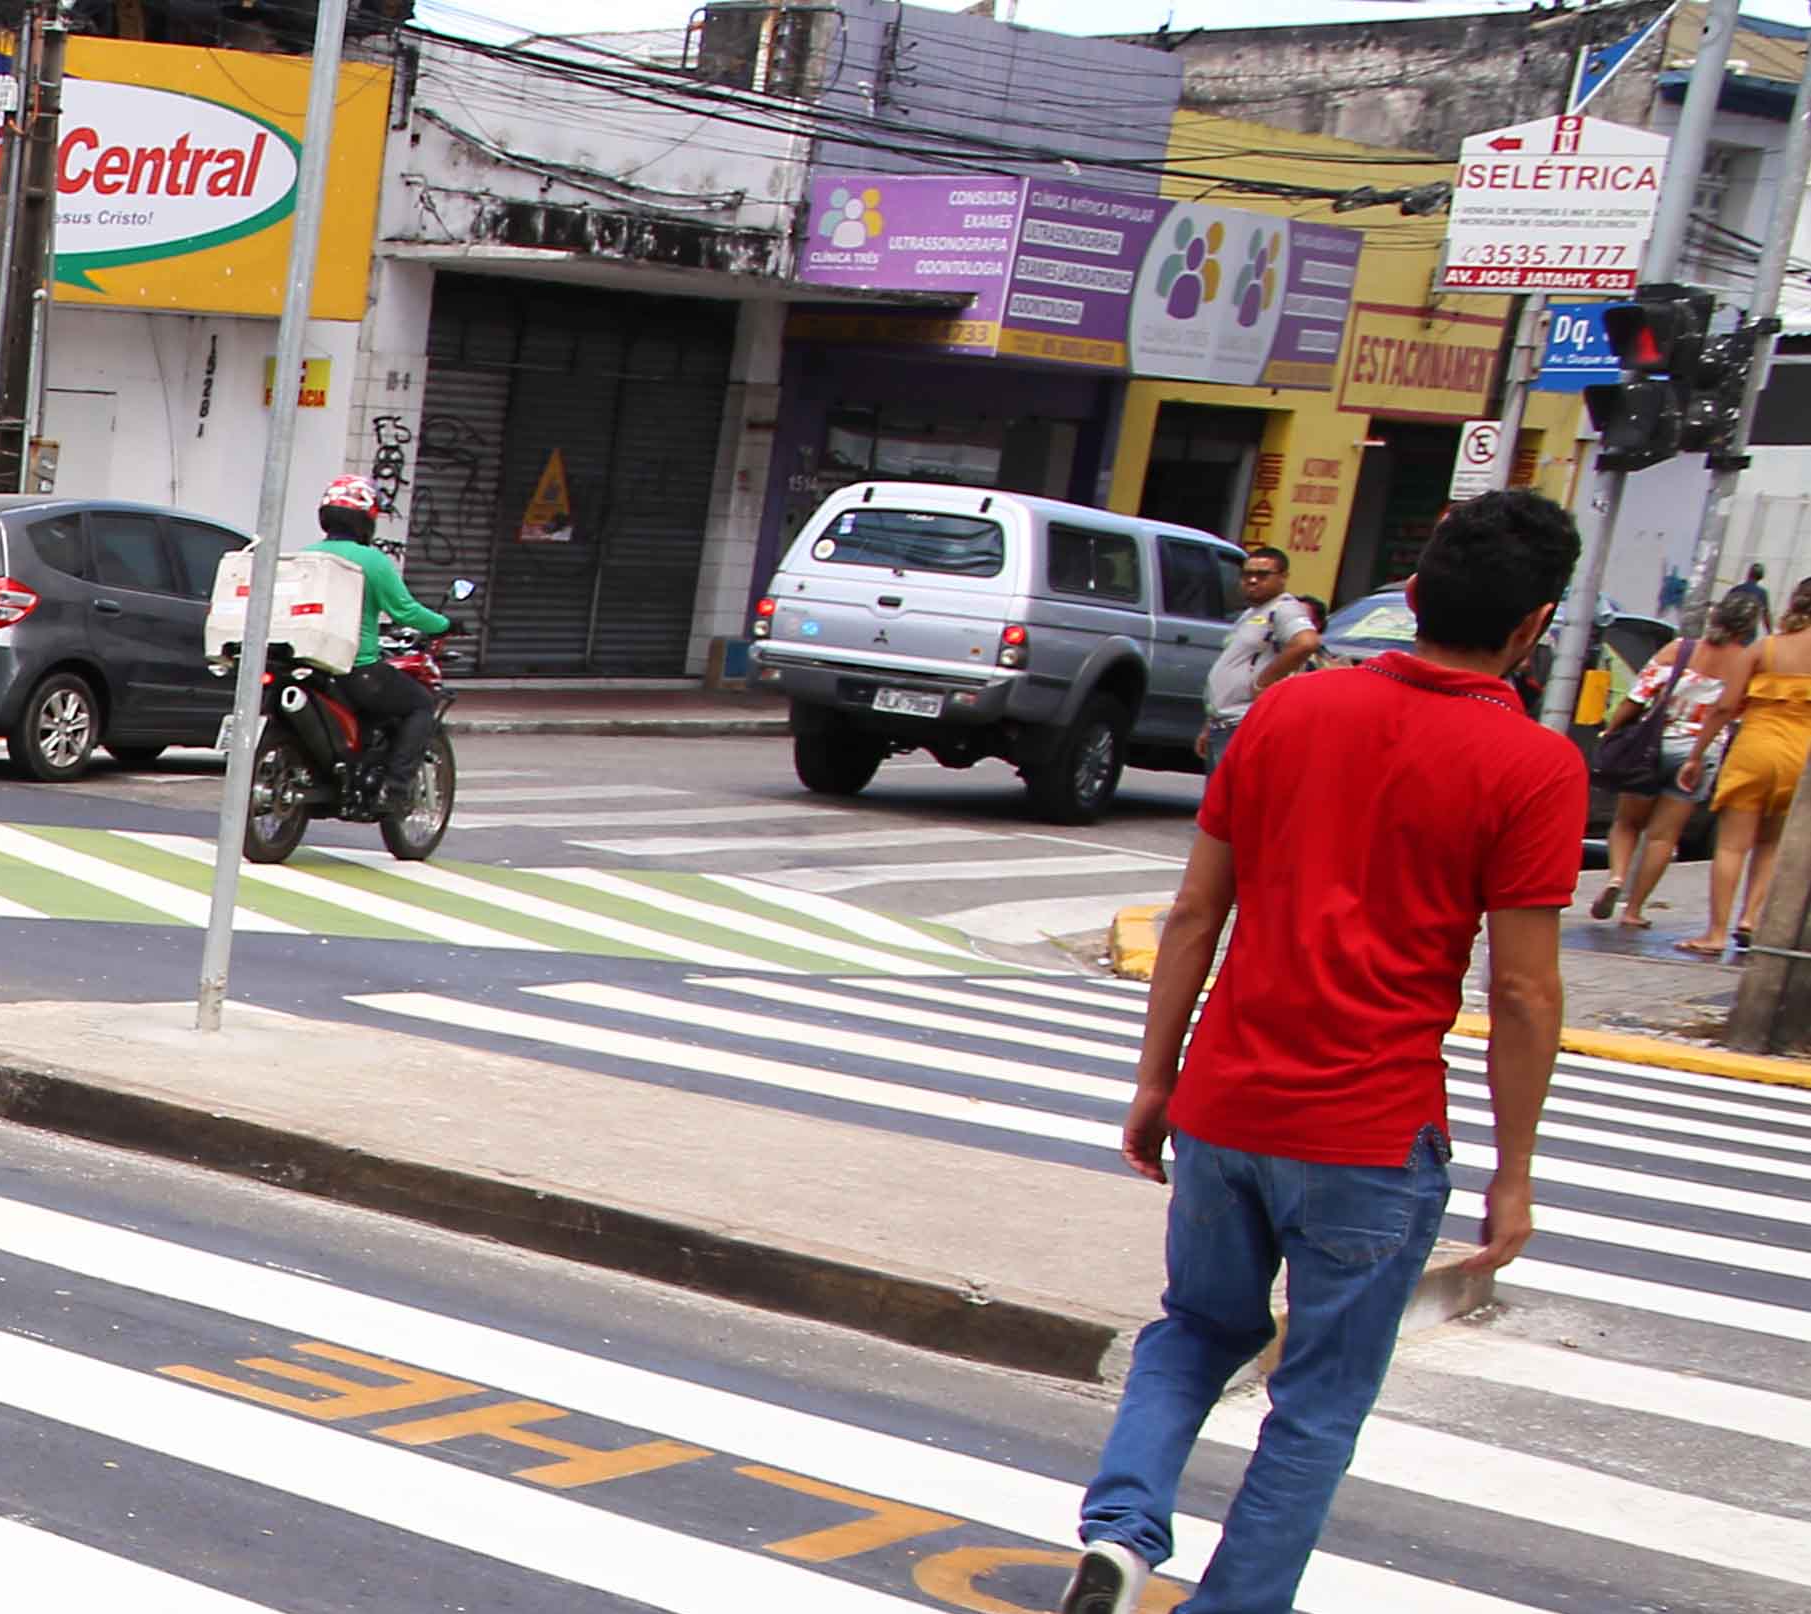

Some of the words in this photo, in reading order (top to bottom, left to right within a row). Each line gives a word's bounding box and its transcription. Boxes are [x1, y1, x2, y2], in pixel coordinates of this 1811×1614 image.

[57, 127, 266, 197] Central
[1455, 160, 1657, 191] ISELÉTRICA
[98, 210, 153, 225] Cristo!
[1480, 245, 1627, 266] 3535.7177
[1445, 269, 1474, 284] AV.
[1476, 267, 1521, 286] JOSÉ
[1596, 272, 1629, 288] 933
[1553, 315, 1595, 351] Dq.
